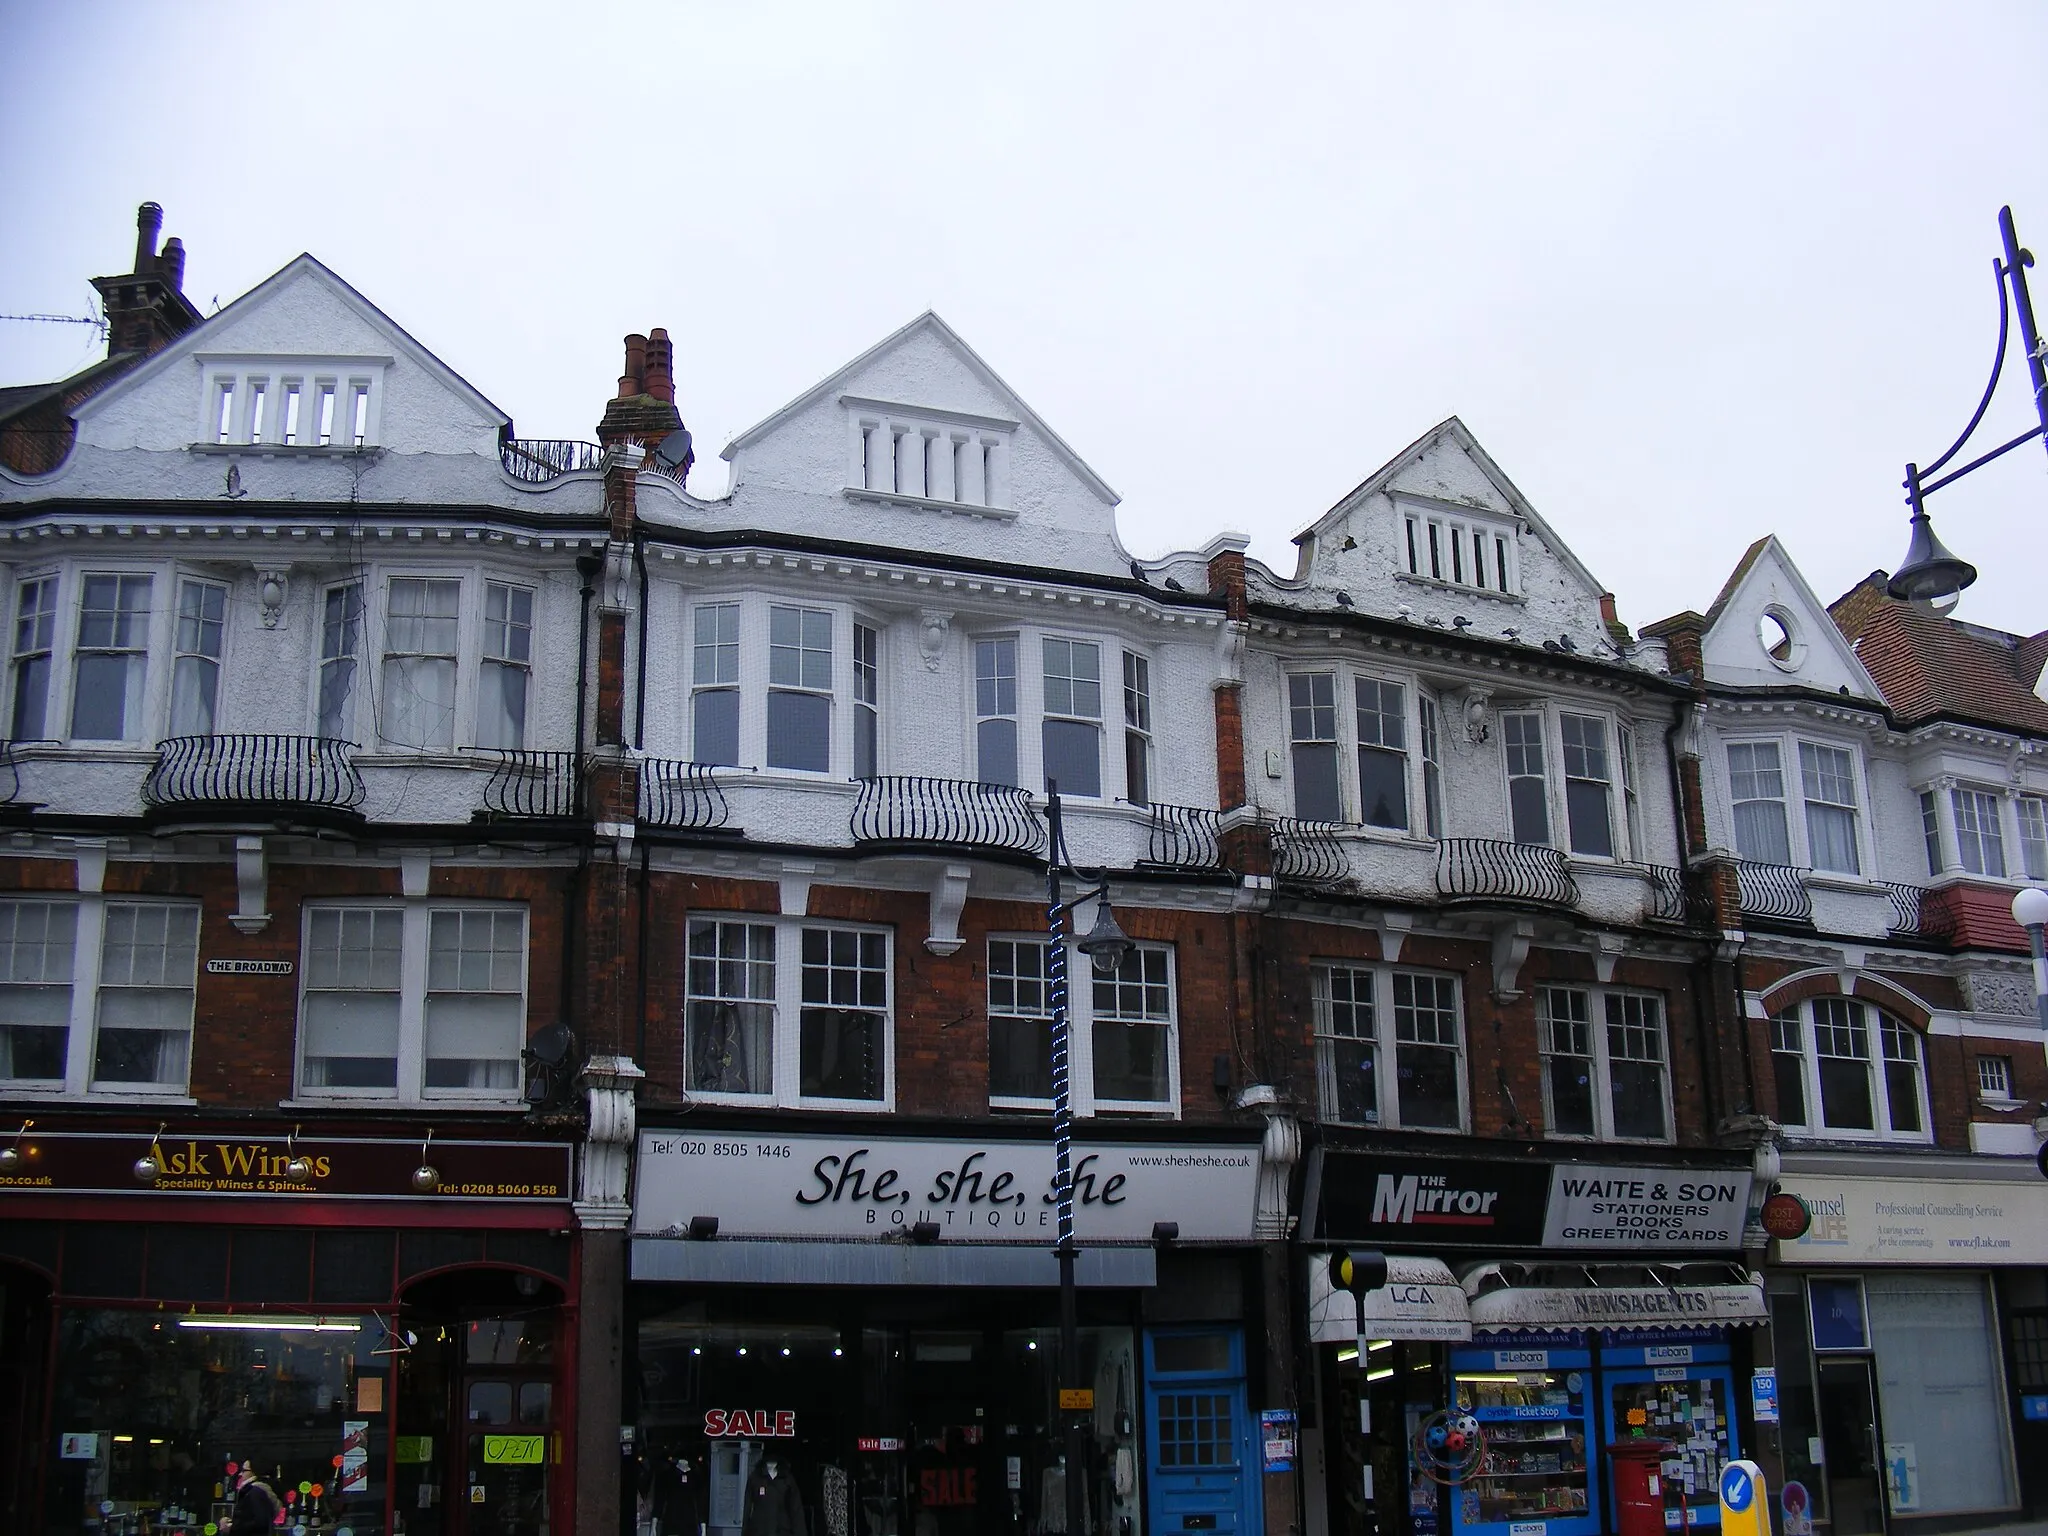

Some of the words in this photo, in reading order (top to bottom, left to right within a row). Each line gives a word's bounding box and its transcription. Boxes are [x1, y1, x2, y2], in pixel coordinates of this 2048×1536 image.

[209, 962, 231, 971] THE
[234, 963, 290, 972] BROADWAY
[651, 1141, 673, 1154] Tel:
[681, 1142, 706, 1155] 020
[713, 1143, 748, 1156] 8505
[757, 1145, 791, 1158] 1446
[1128, 1154, 1250, 1167] www.shesheshe.co.uk
[795, 1149, 911, 1205] She,
[928, 1152, 1026, 1206] she,
[1420, 1176, 1447, 1186] THE
[155, 1178, 213, 1191] Speciality
[217, 1180, 254, 1190] Wines
[257, 1181, 265, 1190] &
[437, 1184, 459, 1194] Tel:
[462, 1184, 494, 1194] 0208
[498, 1185, 530, 1195] 5060
[533, 1185, 557, 1195] 558
[1562, 1180, 1645, 1199] WAITE
[1650, 1183, 1668, 1200] &
[1677, 1184, 1736, 1203] SON
[1372, 1174, 1498, 1223] Mirror
[1800, 1193, 1846, 1216] unsel
[1592, 1203, 1710, 1216] STATIONERS
[1769, 1207, 1793, 1219] POST
[1875, 1202, 1926, 1218] Professional
[1927, 1203, 1975, 1219] Counselling
[1975, 1204, 2004, 1218] Service
[865, 1209, 1048, 1226] BOUTIQUE
[1616, 1216, 1683, 1228] BOOKS
[1767, 1219, 1800, 1231] OFFICE
[1903, 1226, 1925, 1236] service
[1562, 1228, 1661, 1240] GREETING
[1666, 1229, 1729, 1241] CARDS
[1888, 1236, 1898, 1247] the
[1391, 1287, 1435, 1304] LCA
[1573, 1292, 1708, 1314] NEWSAGENTS
[1831, 1307, 1843, 1318] 10
[1509, 1352, 1543, 1362] Lebara
[1658, 1346, 1688, 1357] Lebara
[1756, 1378, 1772, 1390] 150
[1515, 1407, 1539, 1416] Ticket
[1540, 1407, 1559, 1418] Stop
[704, 1408, 795, 1437] SALE
[487, 1438, 542, 1460] OPEN
[862, 1439, 878, 1449] sale
[920, 1467, 977, 1506] SALE
